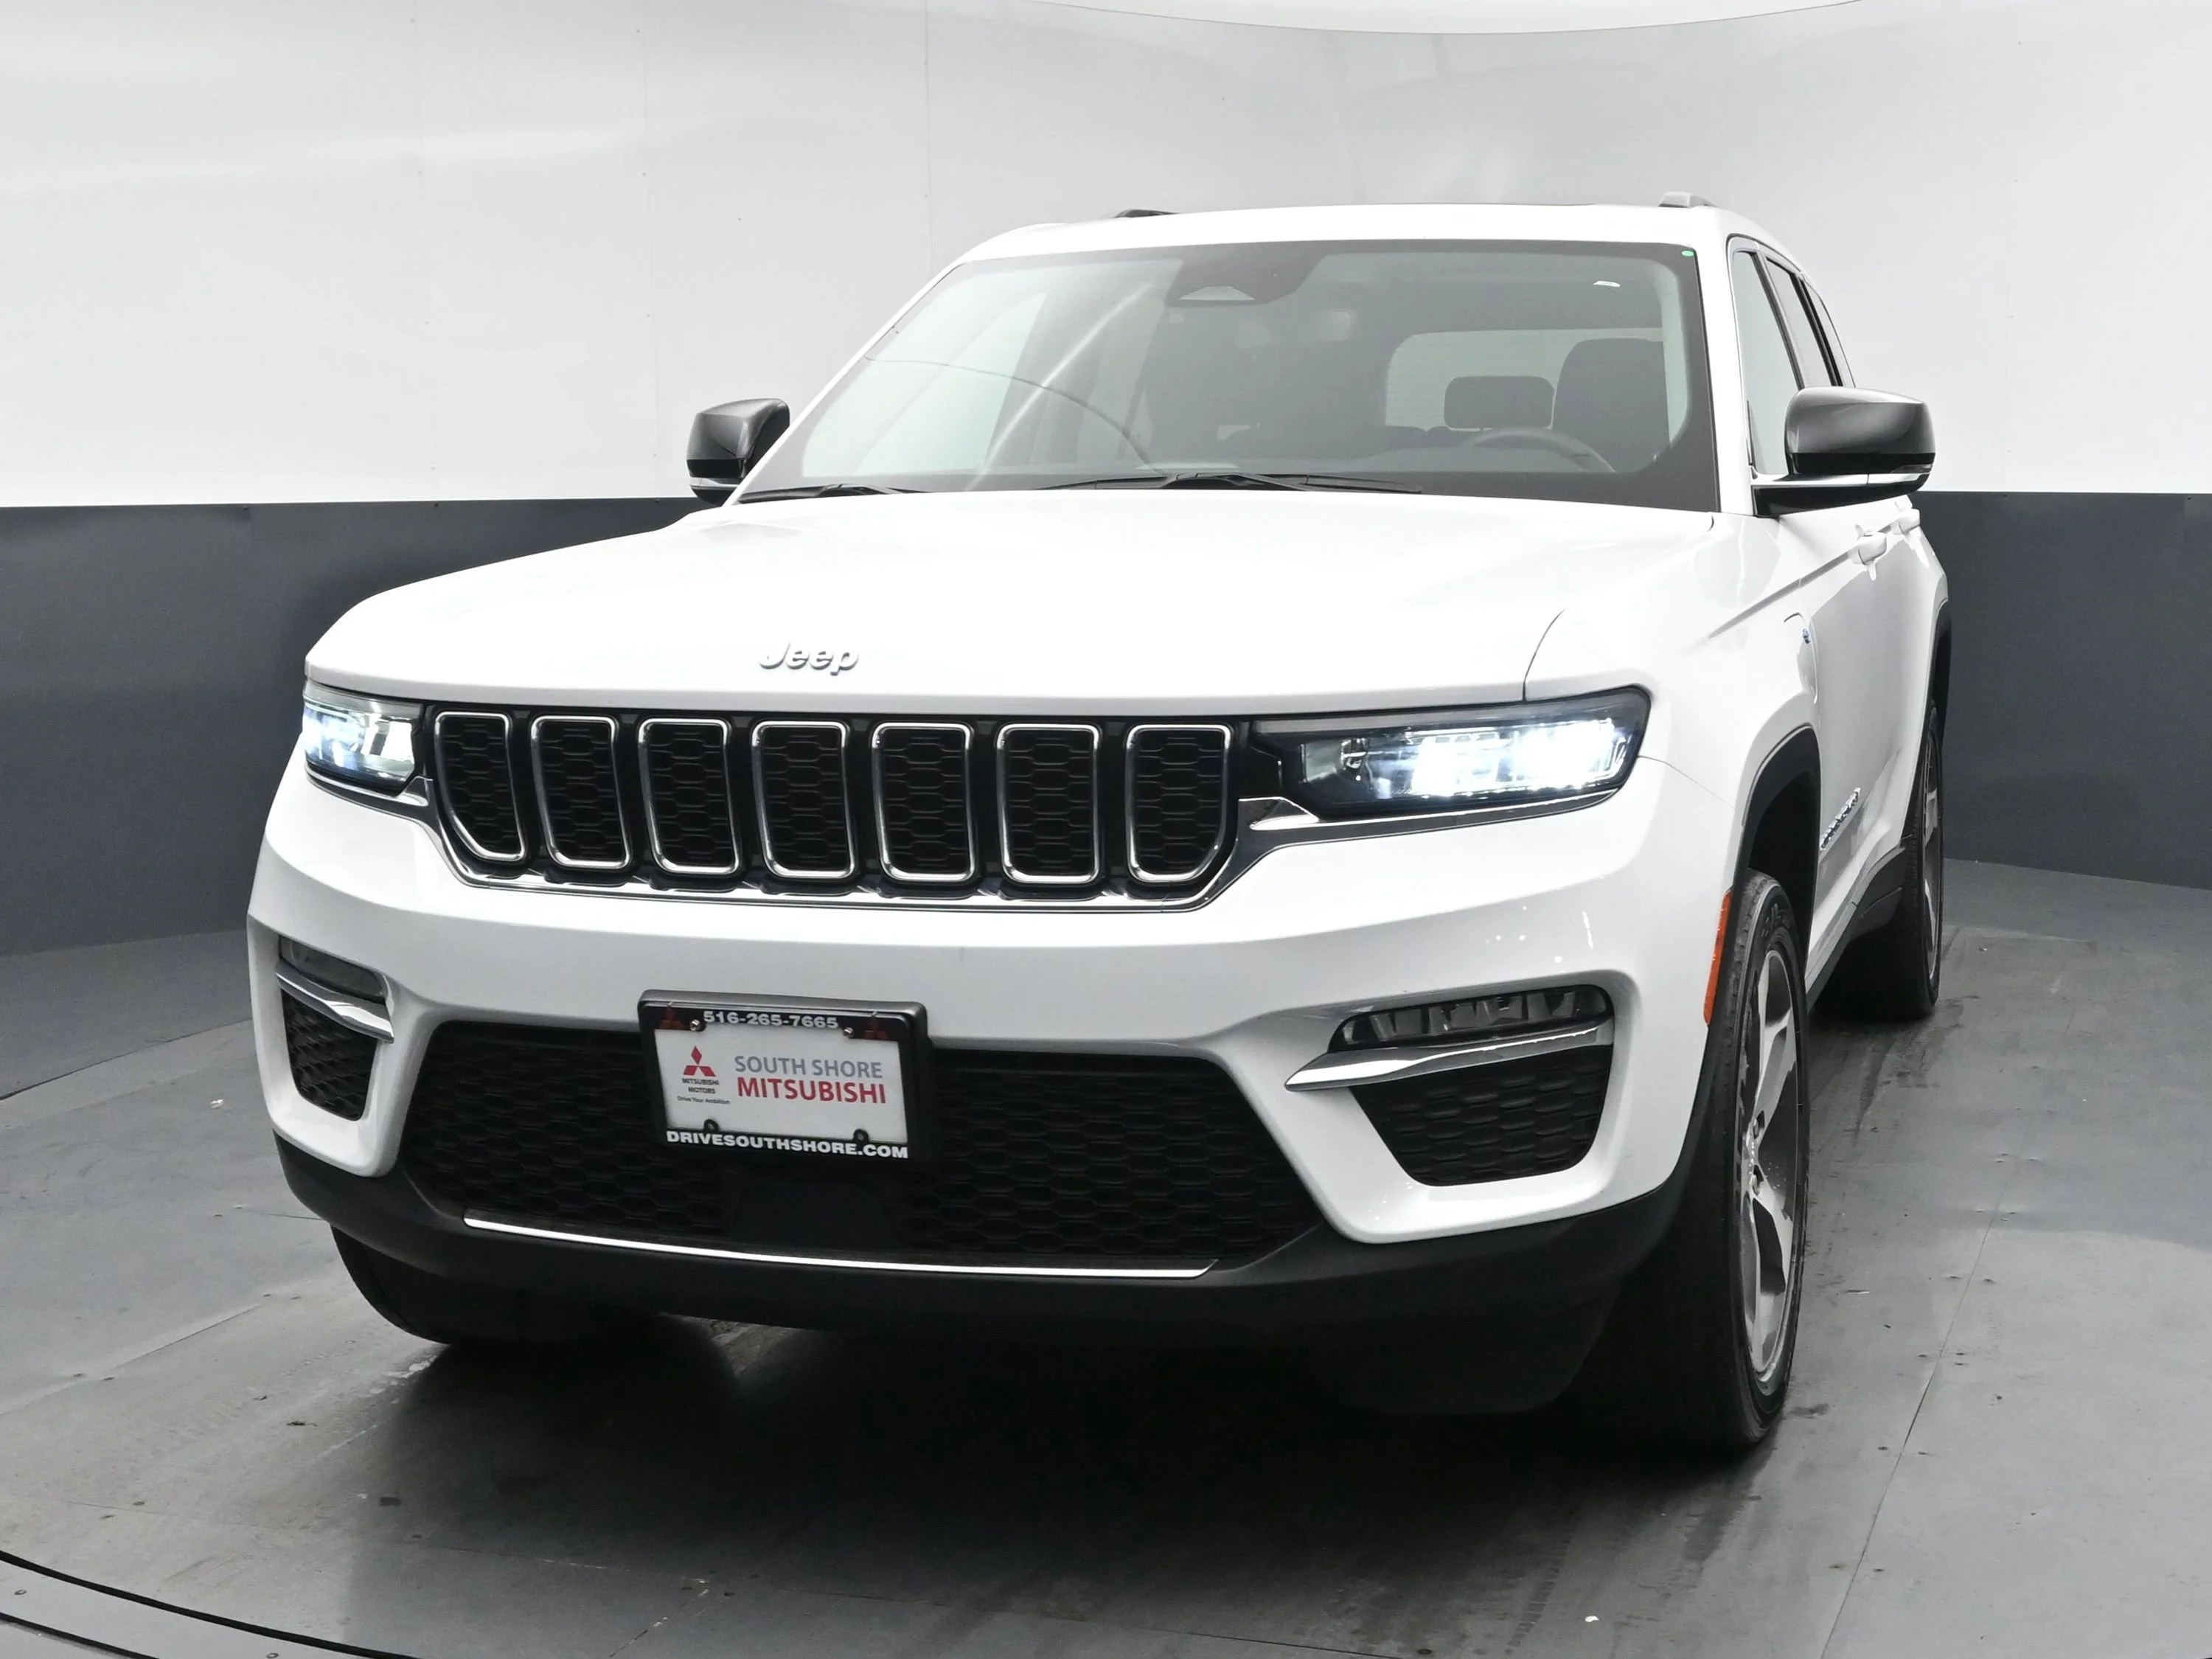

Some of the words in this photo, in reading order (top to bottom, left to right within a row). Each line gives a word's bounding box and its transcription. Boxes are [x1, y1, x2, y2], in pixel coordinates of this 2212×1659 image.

[759, 642, 859, 676] Jeep
[703, 1010, 839, 1029] 516-265-7665
[734, 1055, 807, 1076] SOUTH
[813, 1059, 883, 1079] SHORE
[681, 1078, 720, 1086] MITSUBISHI
[737, 1077, 886, 1104] MITSUBISHI
[667, 1130, 908, 1158] DRIVESOUTHSHORE.COM
